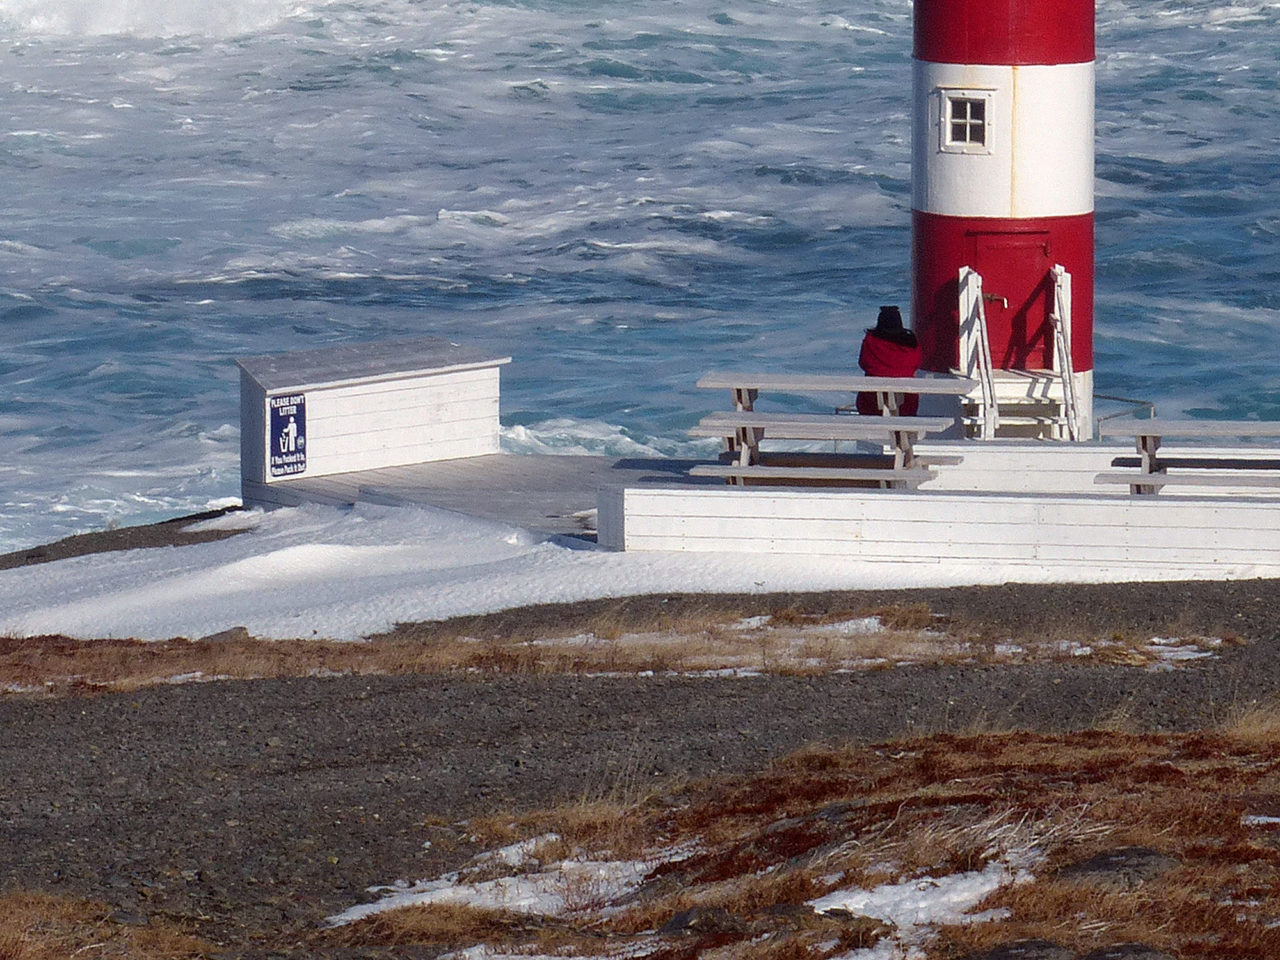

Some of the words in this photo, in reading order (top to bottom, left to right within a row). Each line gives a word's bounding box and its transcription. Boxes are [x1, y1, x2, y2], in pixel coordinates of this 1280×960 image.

[271, 398, 289, 408] PLEASE
[290, 395, 304, 405] DON'T
[279, 405, 297, 416] LITTER
